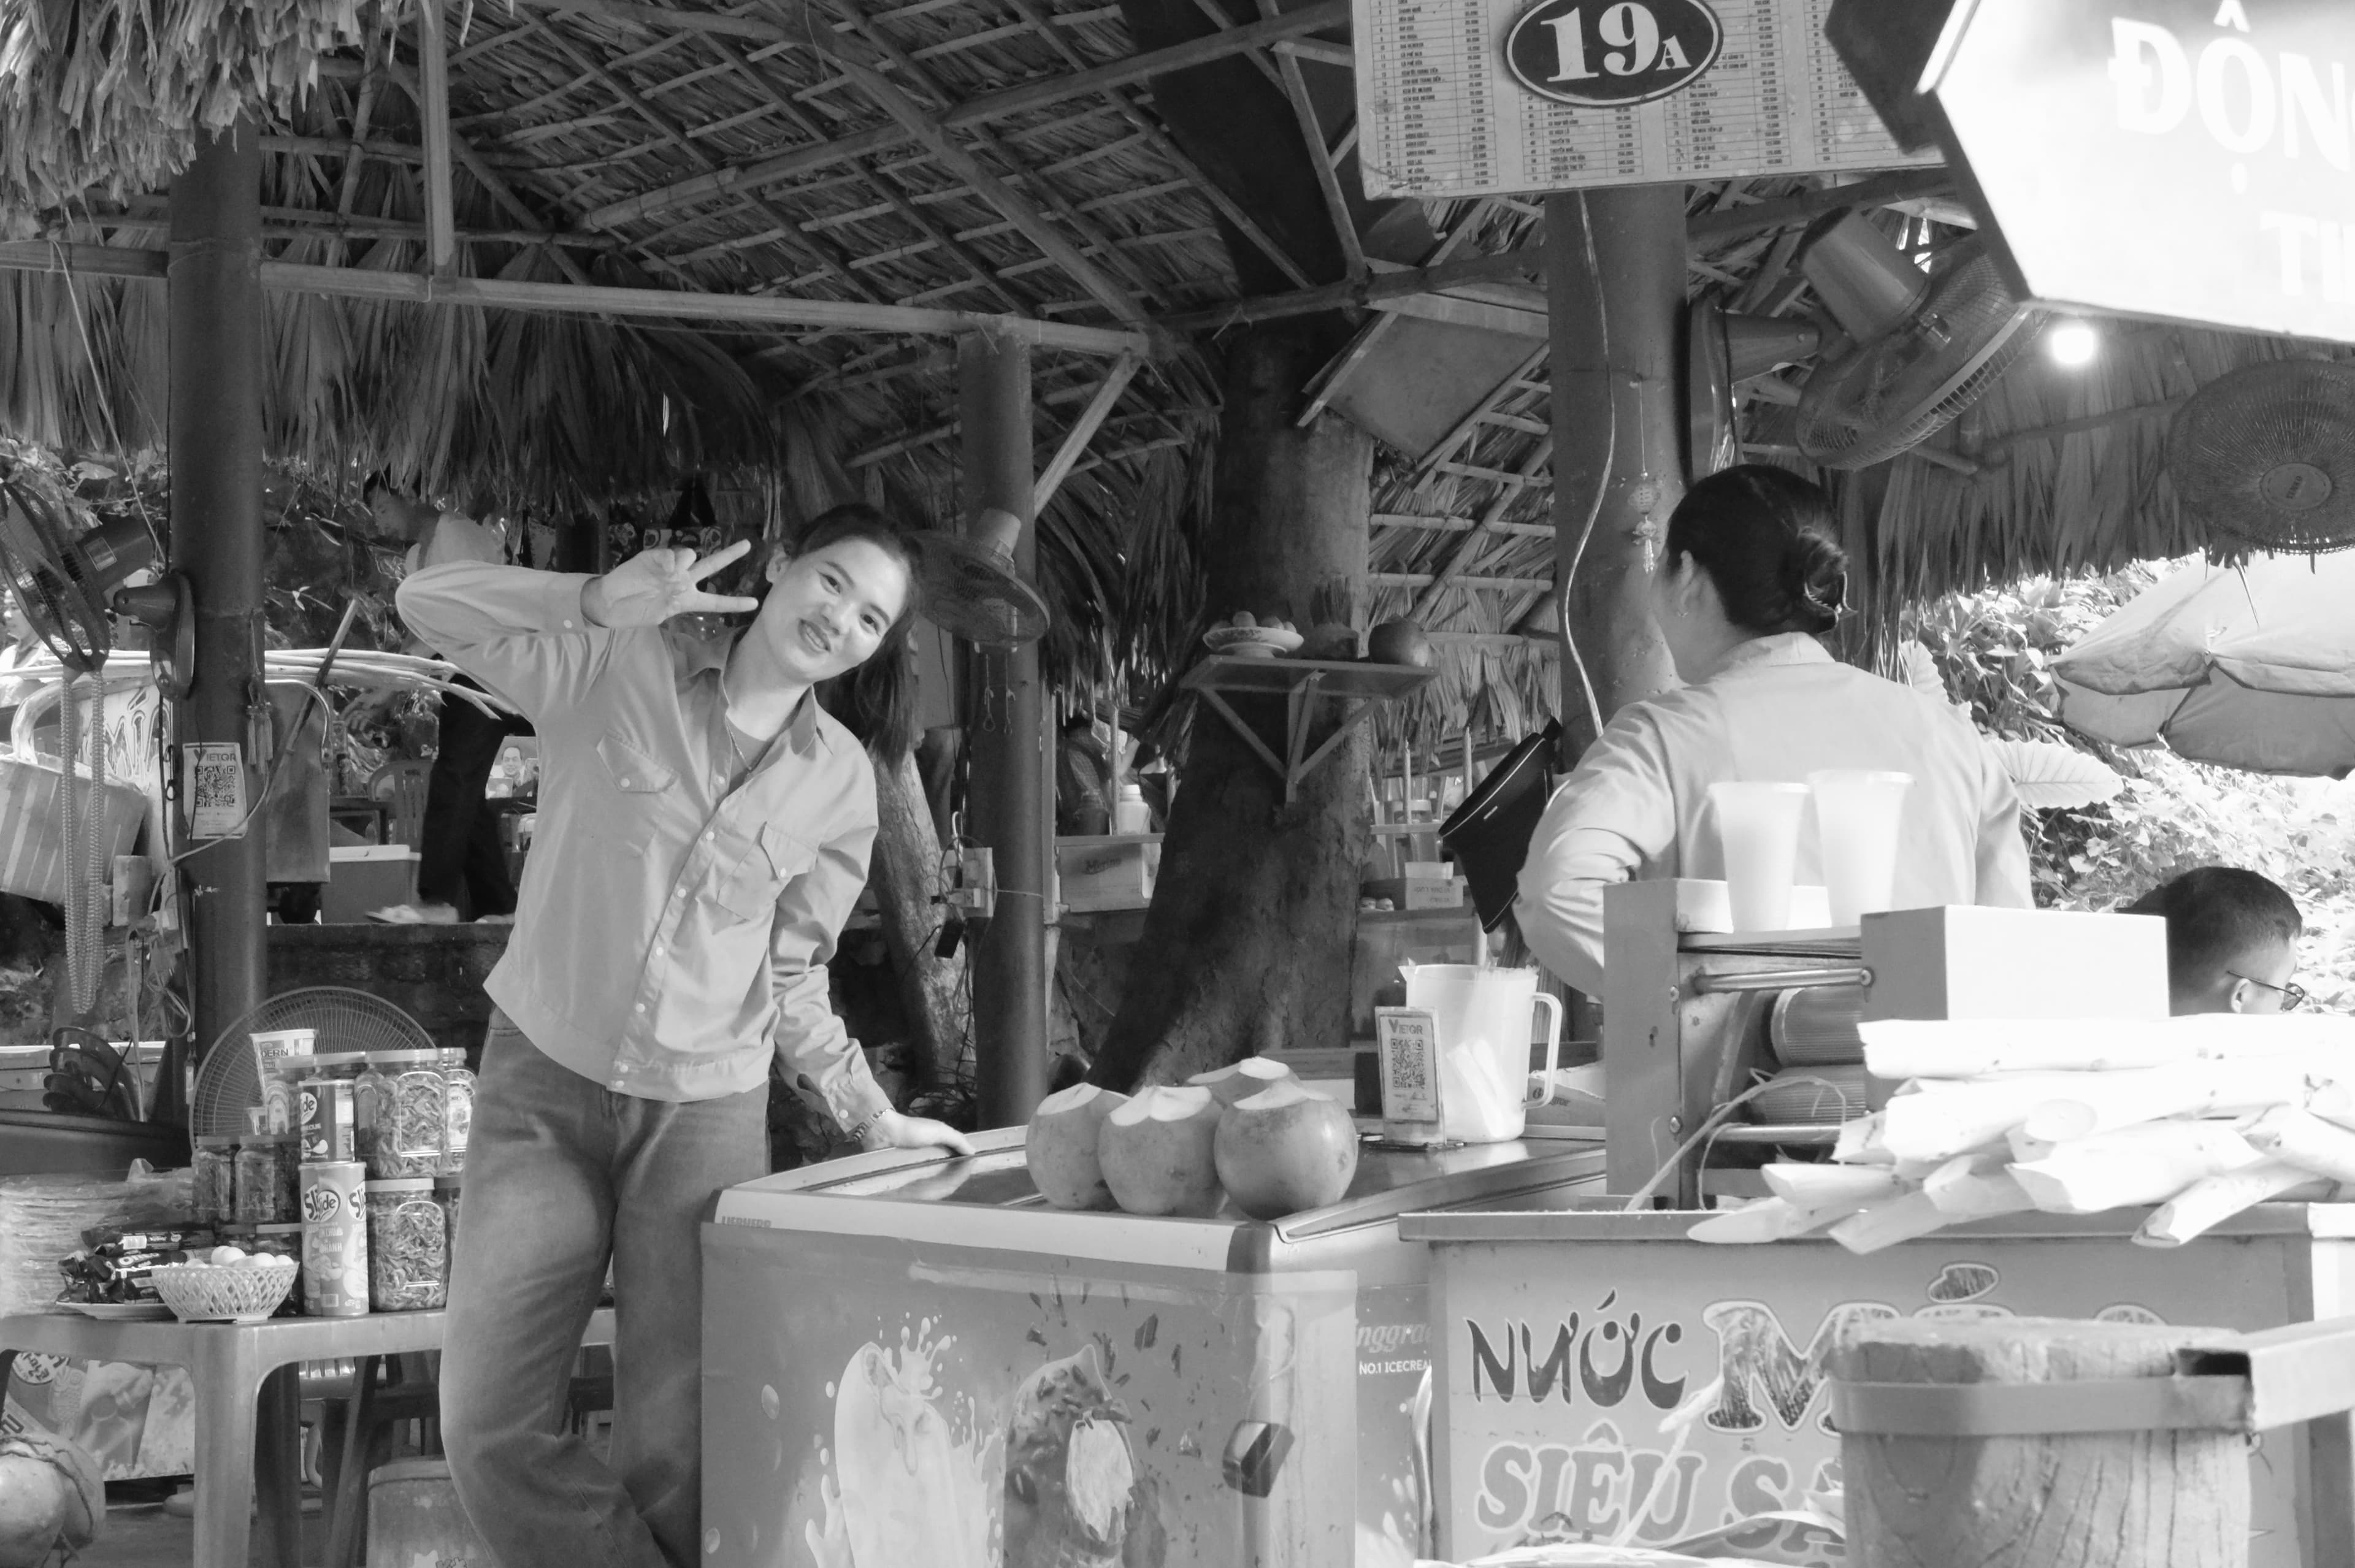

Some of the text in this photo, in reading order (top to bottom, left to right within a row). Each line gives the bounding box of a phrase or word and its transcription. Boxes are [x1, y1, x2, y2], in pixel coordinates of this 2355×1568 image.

[1540, 2, 1691, 82] 19A
[2107, 0, 2355, 195] ĐỘN
[1358, 1361, 1382, 1375] NO.1
[1464, 1288, 1690, 1410] NƯỚC
